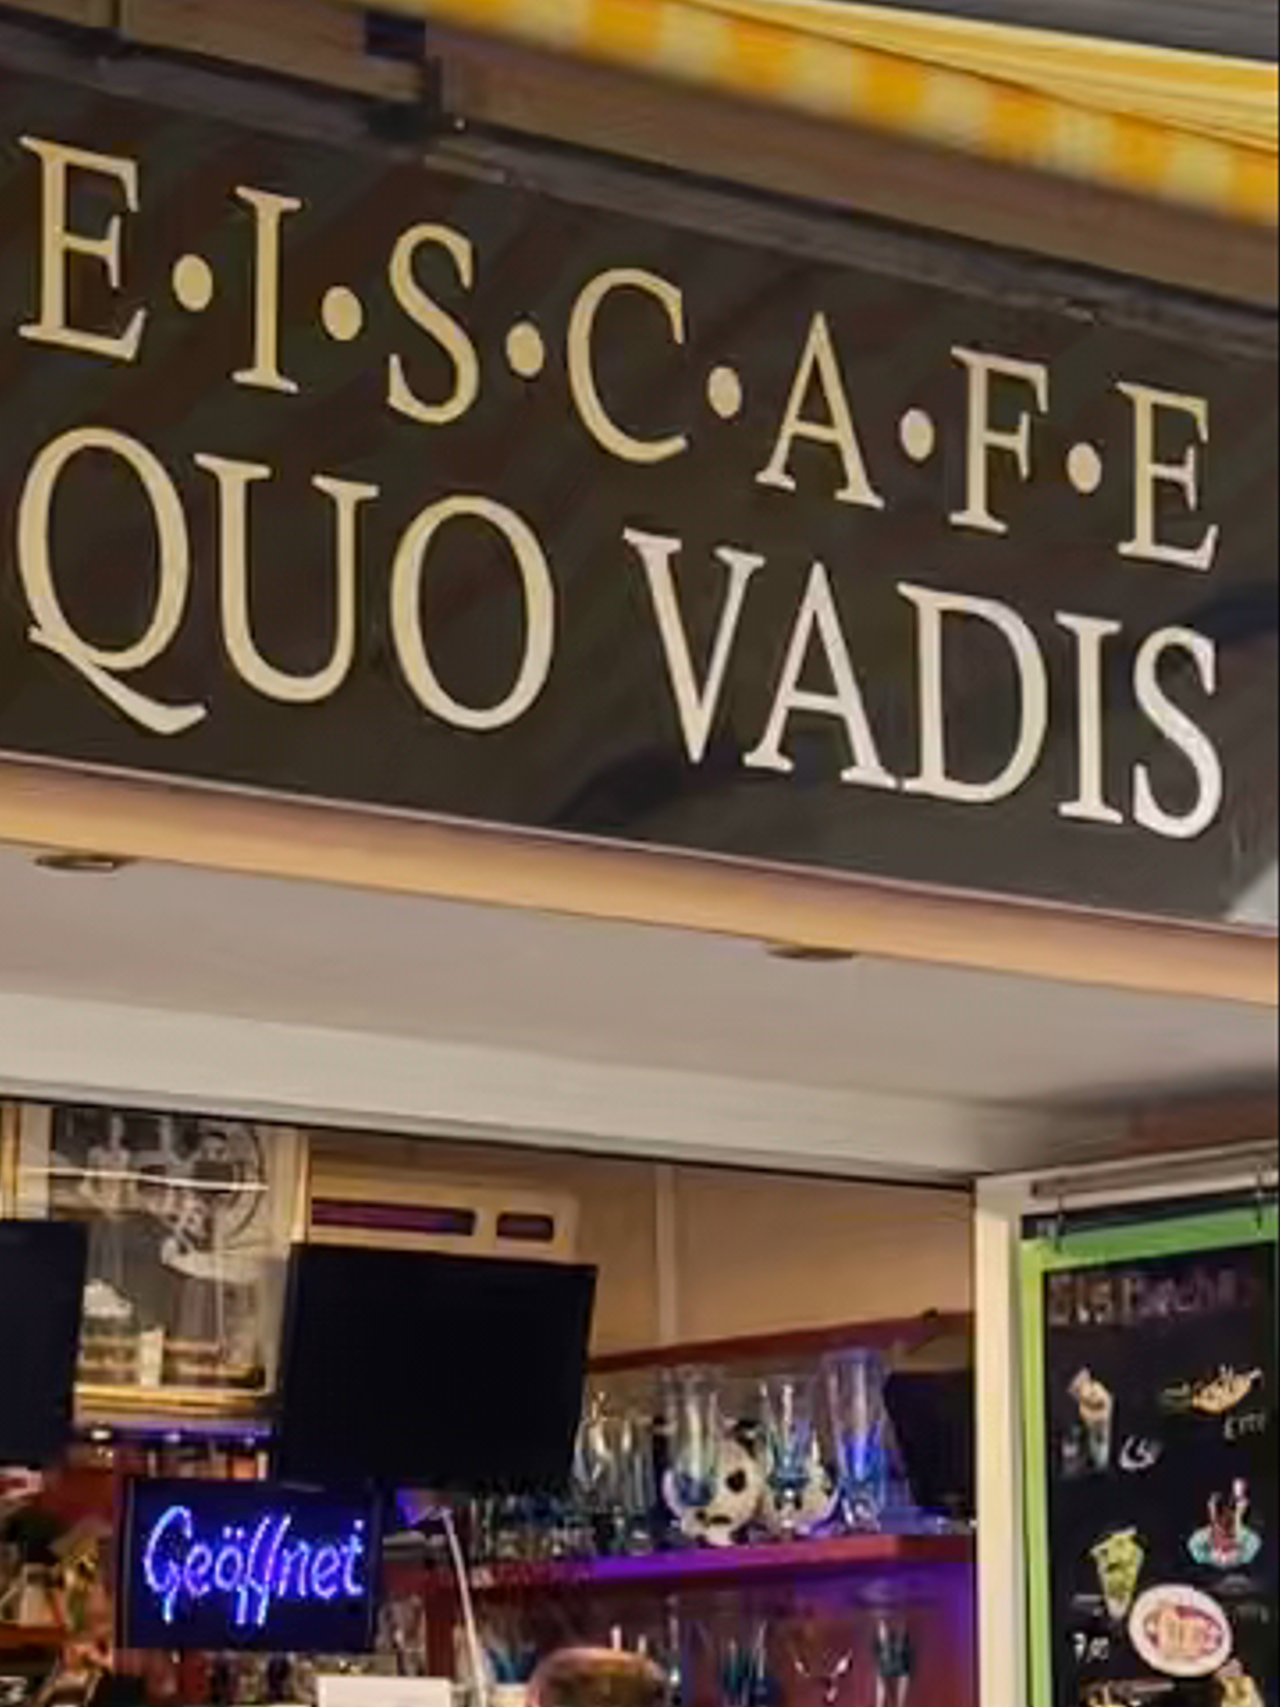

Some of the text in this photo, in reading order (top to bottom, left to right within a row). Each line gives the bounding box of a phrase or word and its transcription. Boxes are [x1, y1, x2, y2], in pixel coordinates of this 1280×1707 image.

[15, 425, 1225, 841] QUO VADIS
[142, 1504, 366, 1627] Geöffnet
